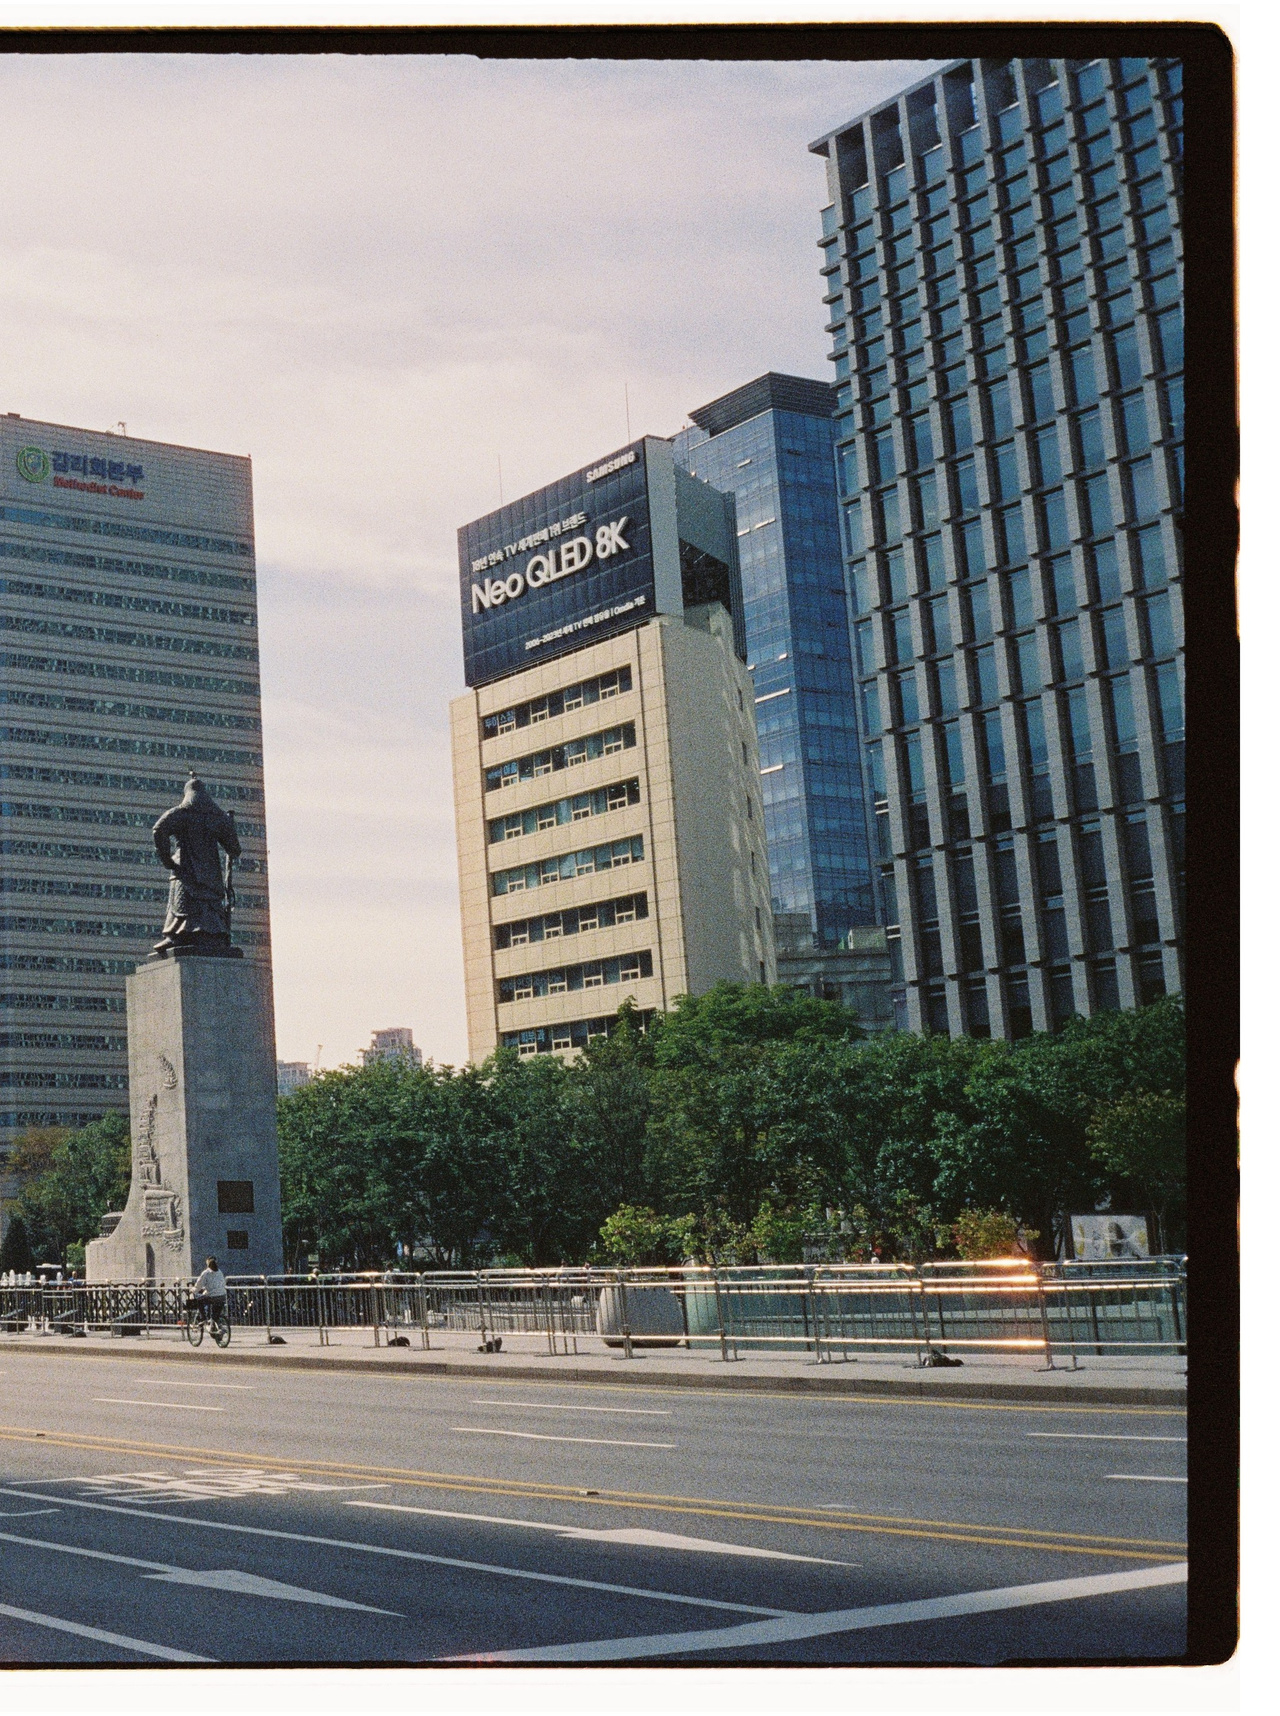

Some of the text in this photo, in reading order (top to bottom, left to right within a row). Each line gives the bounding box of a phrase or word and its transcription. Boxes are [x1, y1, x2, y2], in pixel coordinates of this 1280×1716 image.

[52, 450, 145, 483] 감리회본부
[585, 450, 636, 483] SAMSUNG
[53, 475, 145, 500] Methodist Center
[504, 542, 518, 558] TV
[561, 511, 588, 532] 브랜드
[471, 516, 631, 614] Neo QLED 8K
[8, 1469, 391, 1505] 광화문
